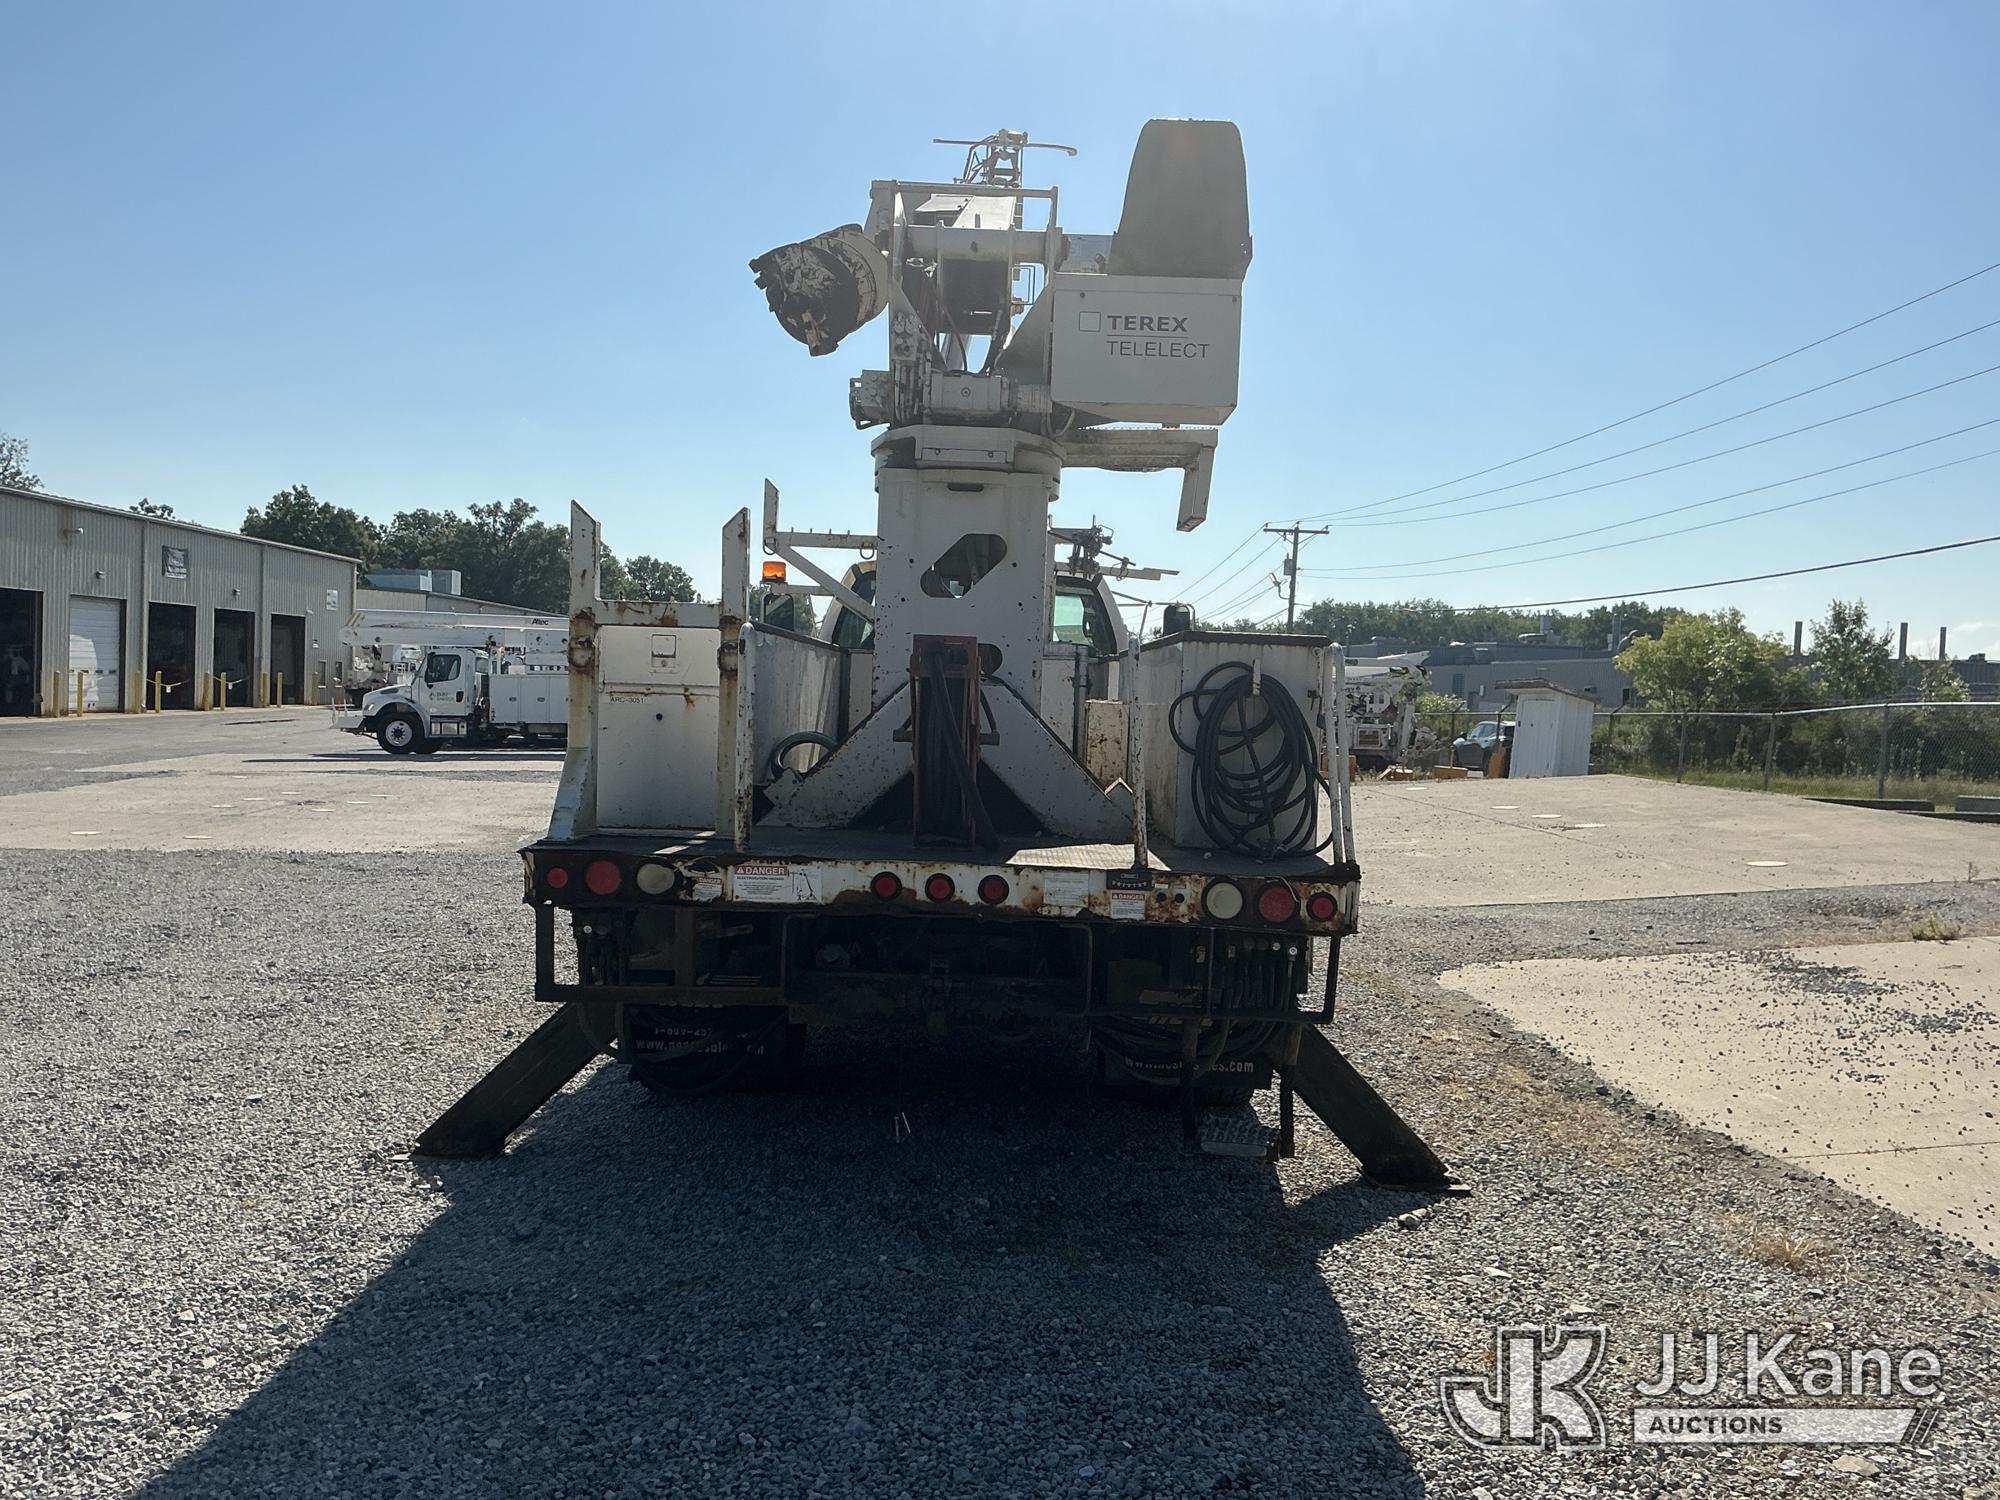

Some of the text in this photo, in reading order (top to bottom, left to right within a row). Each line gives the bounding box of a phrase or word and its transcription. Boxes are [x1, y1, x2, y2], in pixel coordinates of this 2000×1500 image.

[1107, 315, 1188, 332] TEREX
[1106, 341, 1210, 358] TELELECT
[745, 866, 785, 875] DANGER
